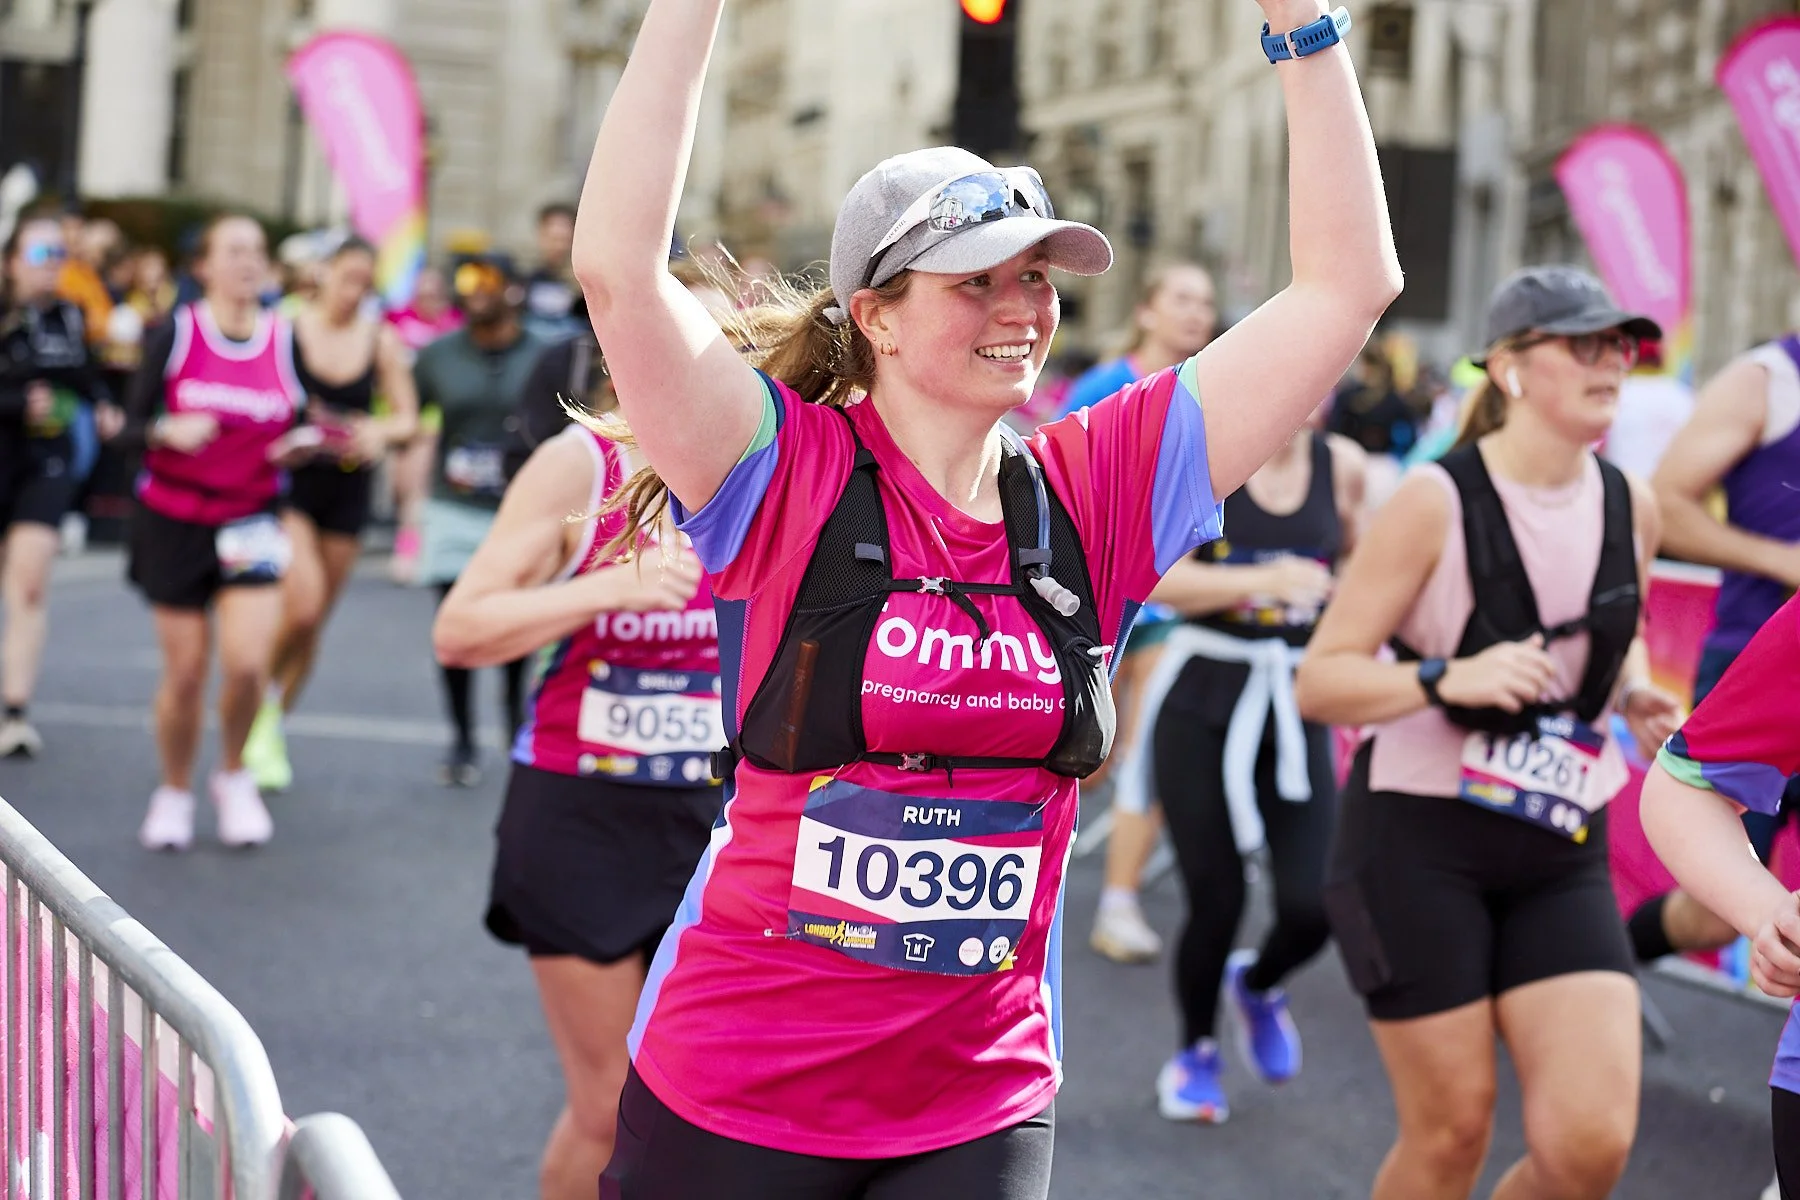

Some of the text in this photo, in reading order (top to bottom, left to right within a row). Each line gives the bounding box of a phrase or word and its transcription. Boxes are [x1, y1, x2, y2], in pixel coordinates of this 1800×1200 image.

[876, 602, 1062, 685] ommy
[861, 680, 961, 708] pregnancy
[966, 692, 1002, 709] and
[1008, 693, 1054, 714] baby
[606, 703, 711, 743] 9055
[902, 805, 961, 827] RUTH
[818, 835, 1025, 911] 10396
[804, 923, 836, 938] LONDON
[995, 949, 1002, 958] 4
